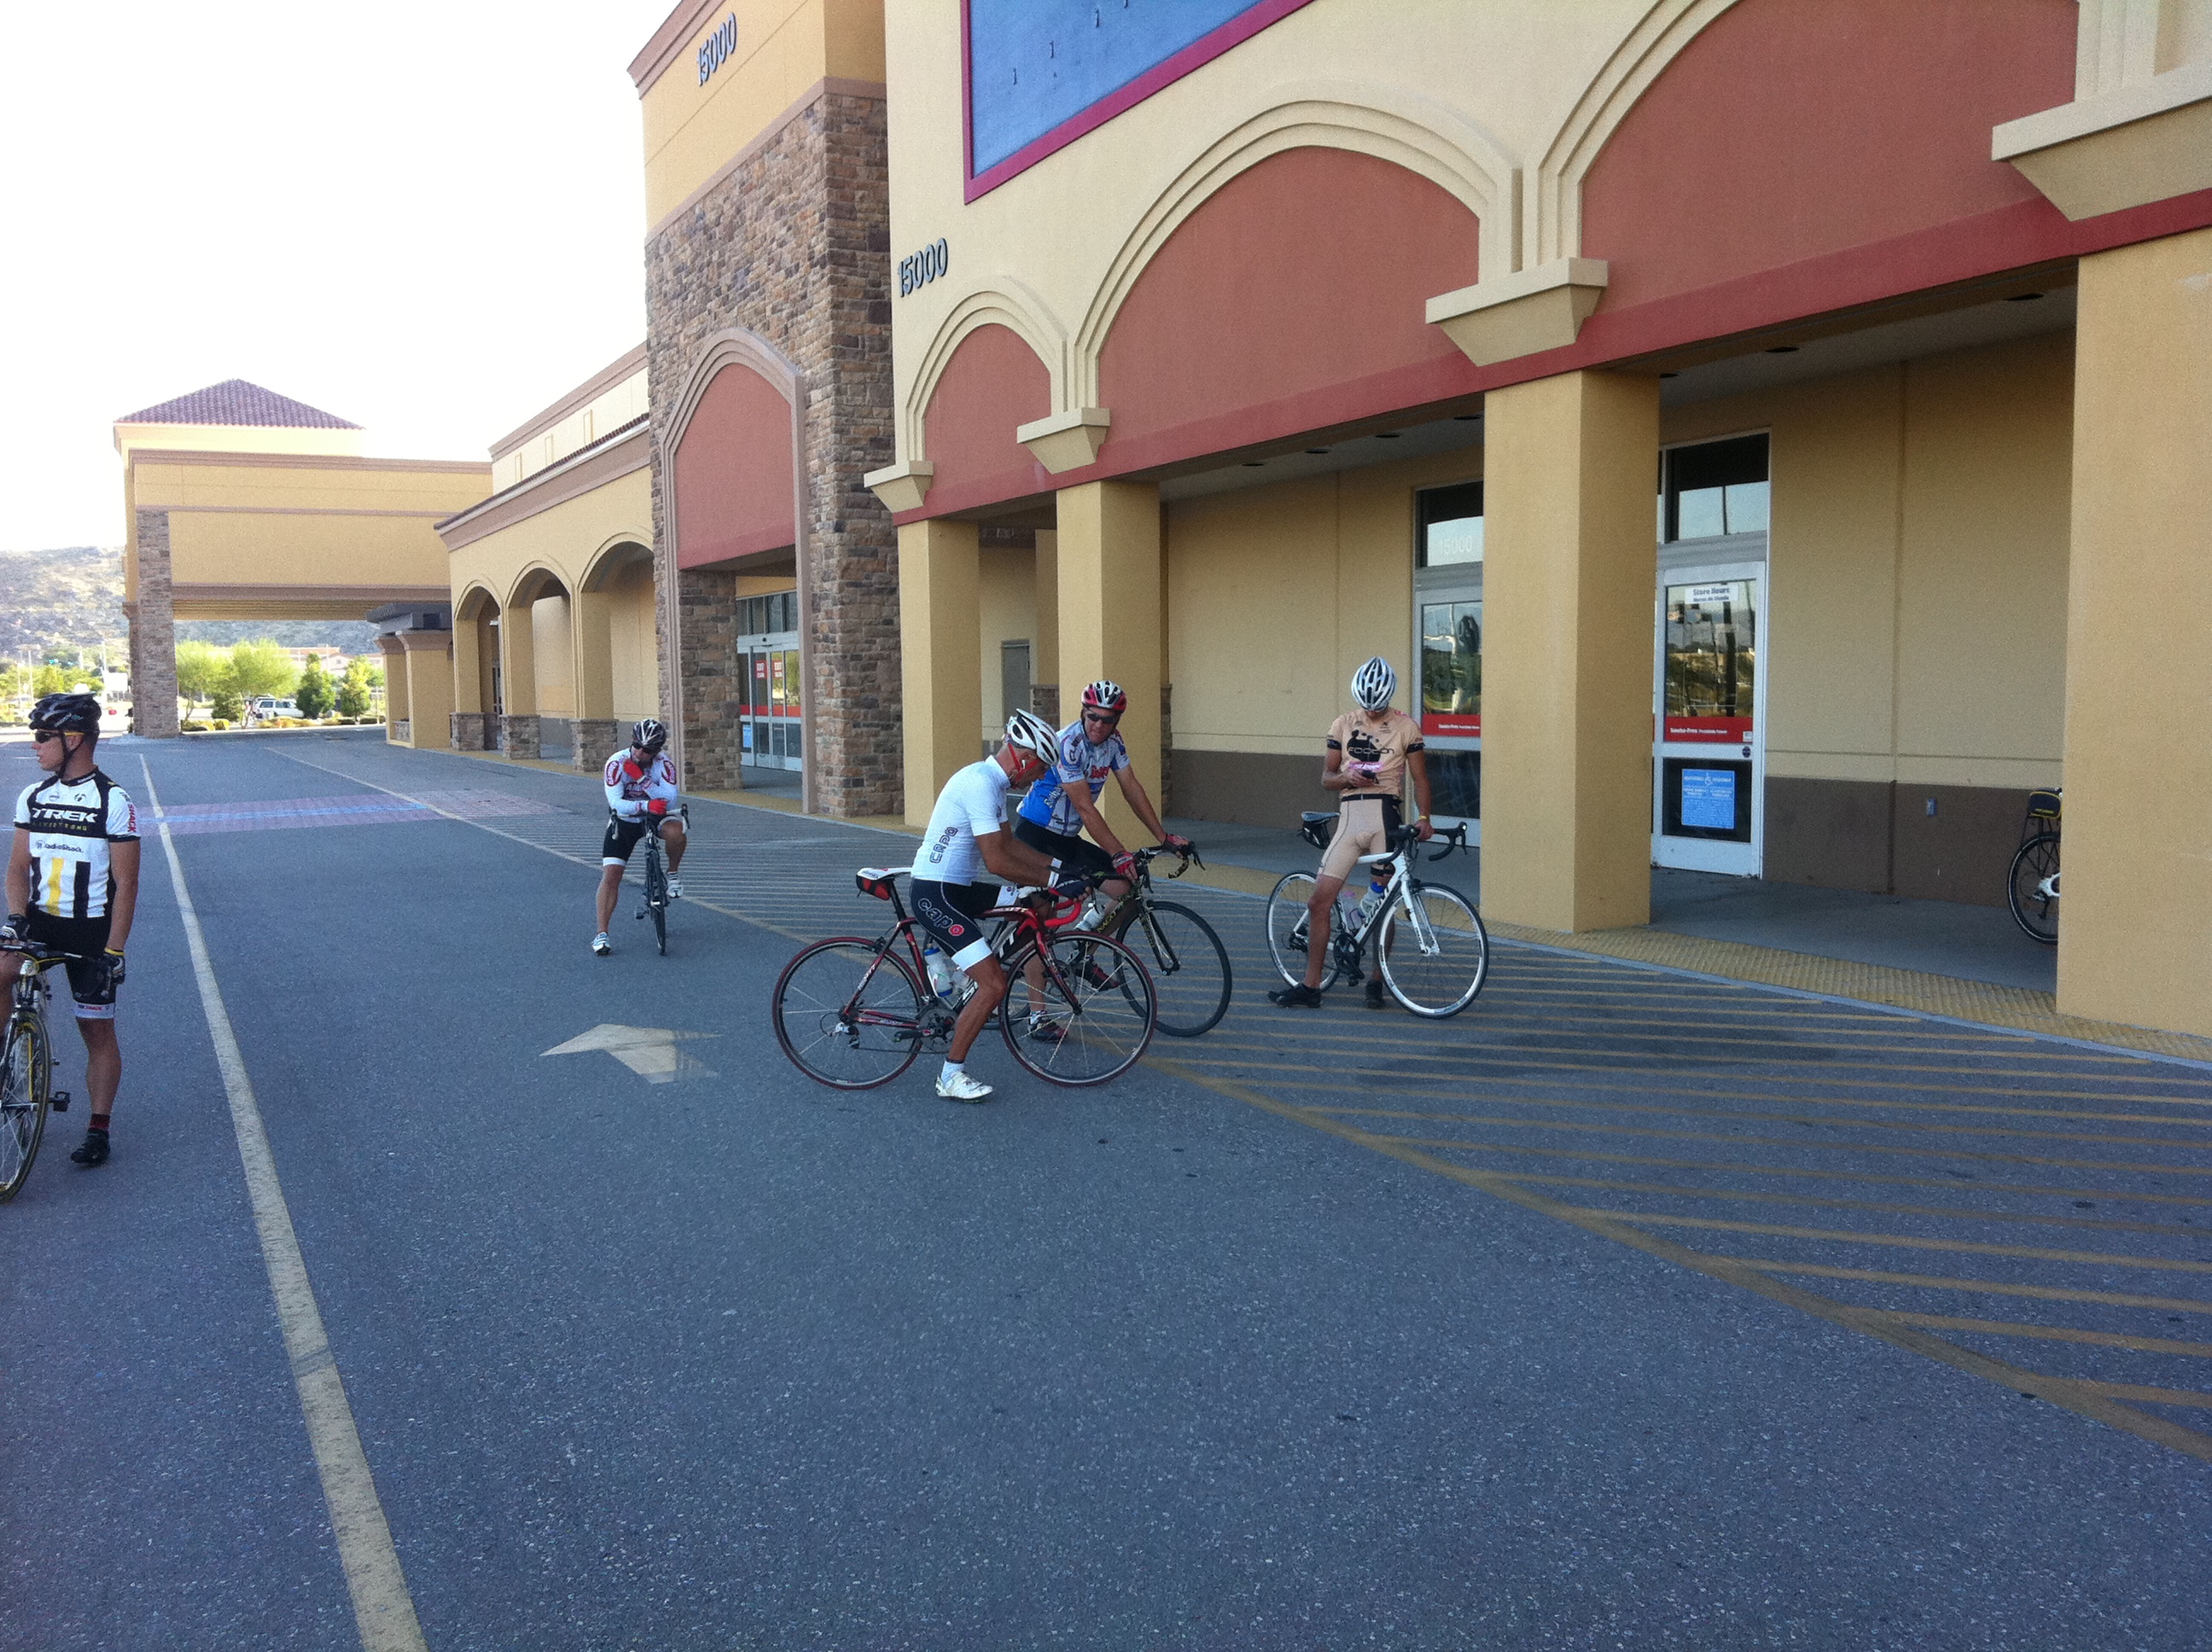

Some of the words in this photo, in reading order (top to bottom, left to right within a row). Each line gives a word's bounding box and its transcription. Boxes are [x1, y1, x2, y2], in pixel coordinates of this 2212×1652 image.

[696, 11, 737, 87] 15000
[898, 237, 948, 298] 15000
[32, 807, 98, 823] TREK
[929, 826, 958, 864] CAPO
